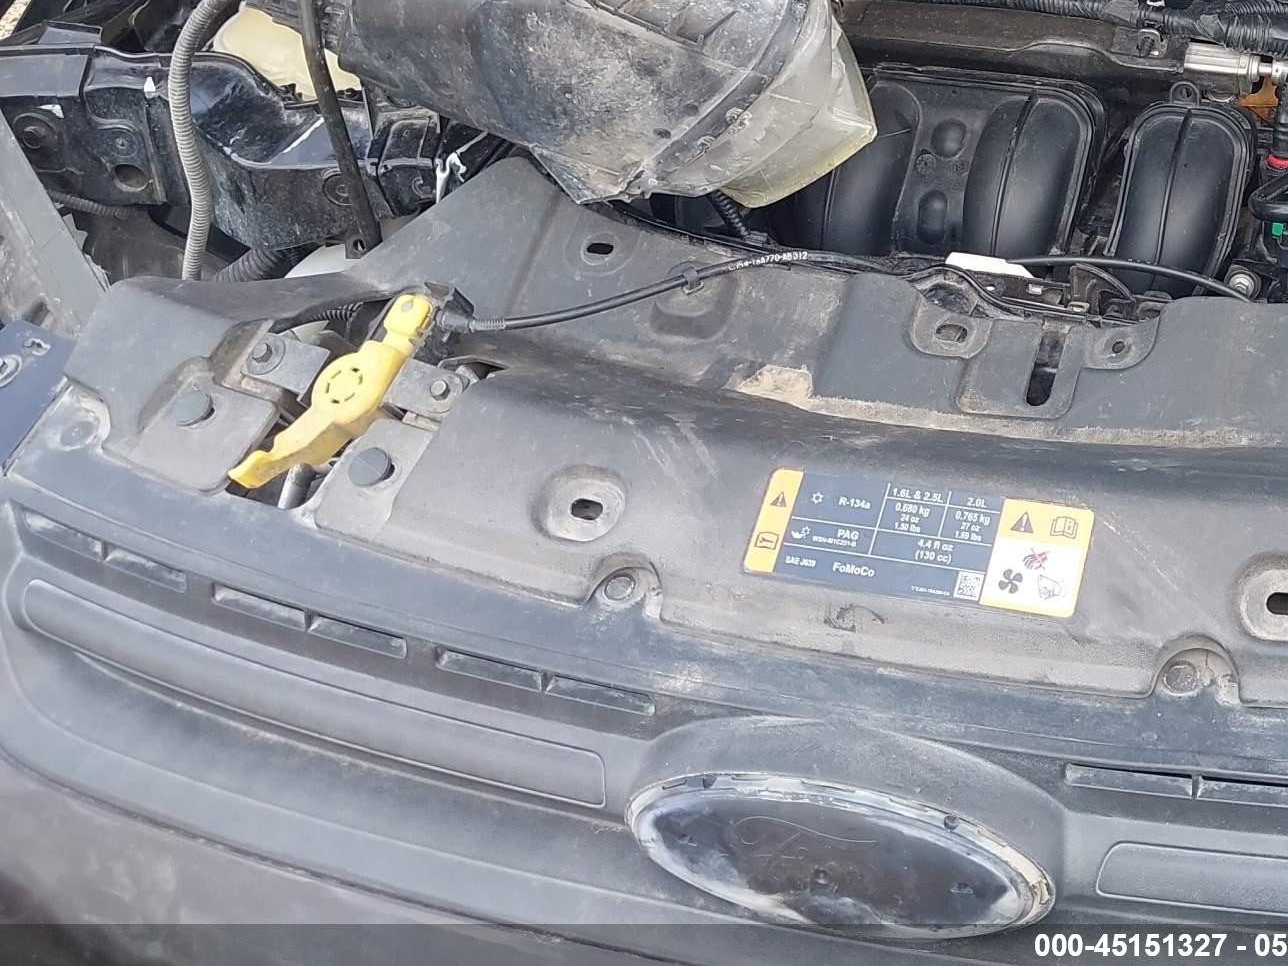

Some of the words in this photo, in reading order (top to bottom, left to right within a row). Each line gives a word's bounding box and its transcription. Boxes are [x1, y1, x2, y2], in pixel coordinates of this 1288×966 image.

[892, 488, 911, 499] 1.6L
[913, 490, 921, 500] &
[923, 491, 943, 503] 2.5L
[838, 496, 871, 509] R-134a
[967, 497, 987, 508] 2.0L
[895, 502, 917, 514] 0.680
[918, 505, 930, 517] kg
[911, 516, 920, 524] oz
[955, 510, 978, 522] 0.765
[979, 513, 991, 526] kg
[960, 522, 970, 530] 27
[971, 524, 980, 532] oz
[837, 528, 860, 540] PAG
[917, 538, 931, 548] 4.4
[933, 539, 941, 550] fl
[942, 543, 954, 552] oz
[785, 555, 800, 565] SAE
[915, 550, 935, 561] (130
[936, 553, 952, 565] cc)
[832, 561, 875, 577] FoMoCo
